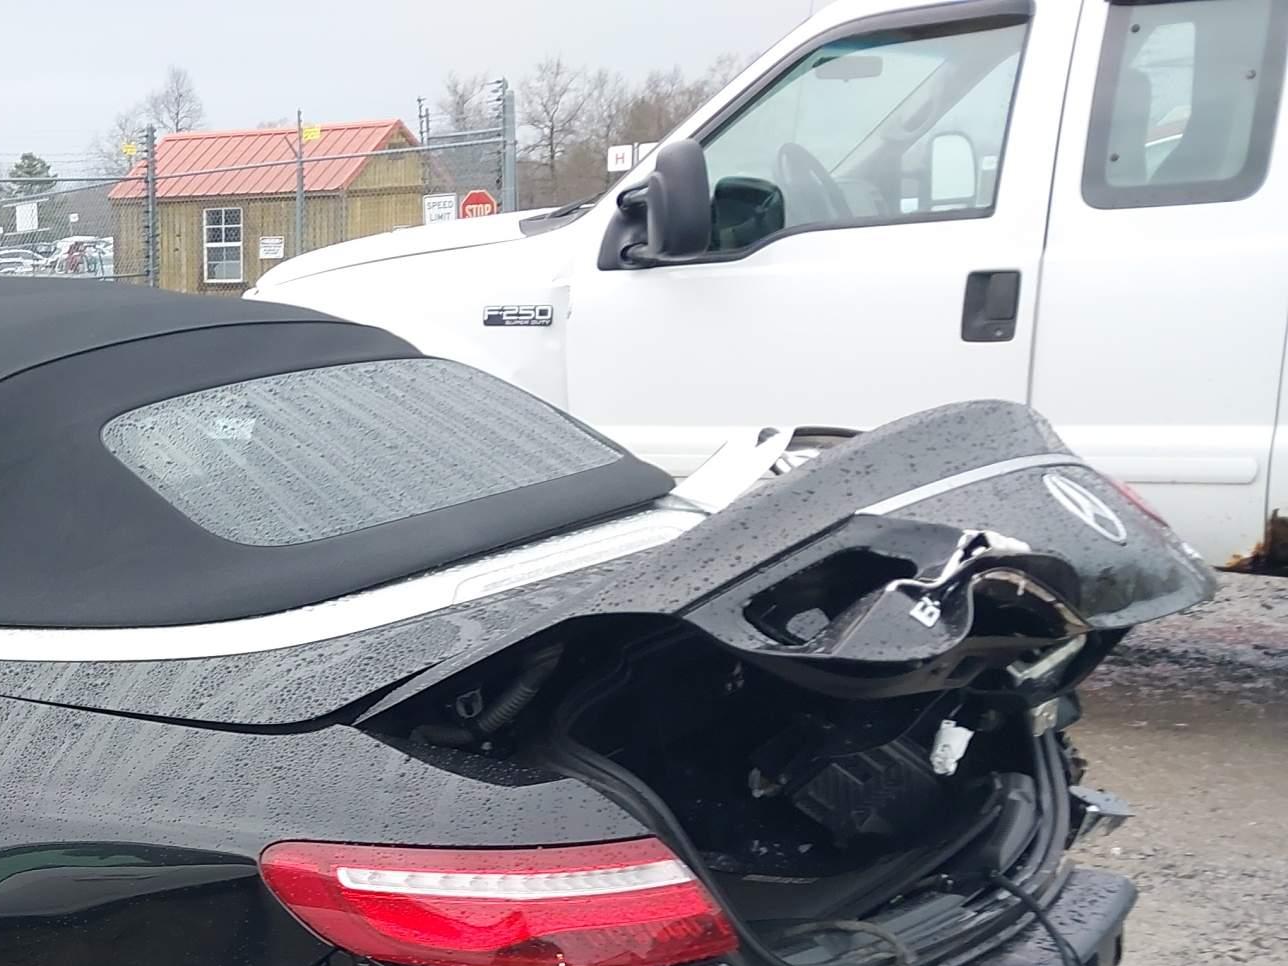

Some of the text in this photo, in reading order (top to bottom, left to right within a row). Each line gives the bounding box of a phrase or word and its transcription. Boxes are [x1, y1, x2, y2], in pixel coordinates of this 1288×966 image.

[615, 152, 625, 165] H
[426, 200, 454, 210] SPEED
[465, 203, 492, 219] STOP
[429, 211, 452, 222] LIMIT
